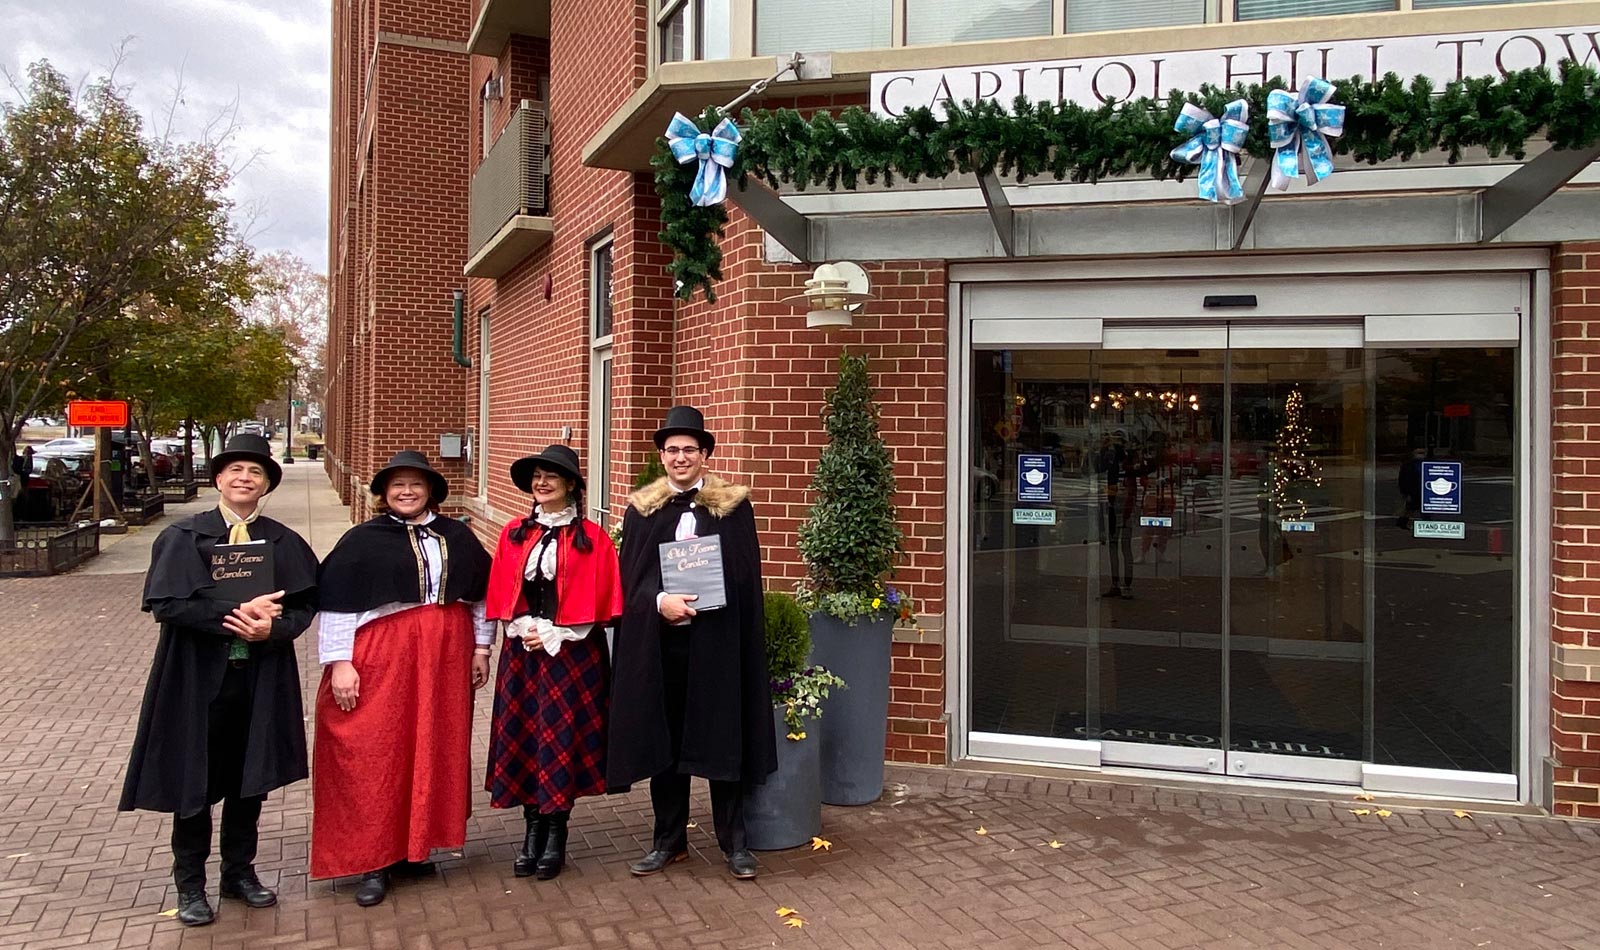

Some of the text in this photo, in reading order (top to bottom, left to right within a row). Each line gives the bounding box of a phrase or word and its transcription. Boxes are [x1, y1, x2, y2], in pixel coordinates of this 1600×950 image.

[880, 58, 1175, 117] CAPITOL
[1439, 523, 1461, 531] CLEAR
[211, 566, 253, 581] Carolers
[1073, 726, 1345, 757] CAPITOL HILL
